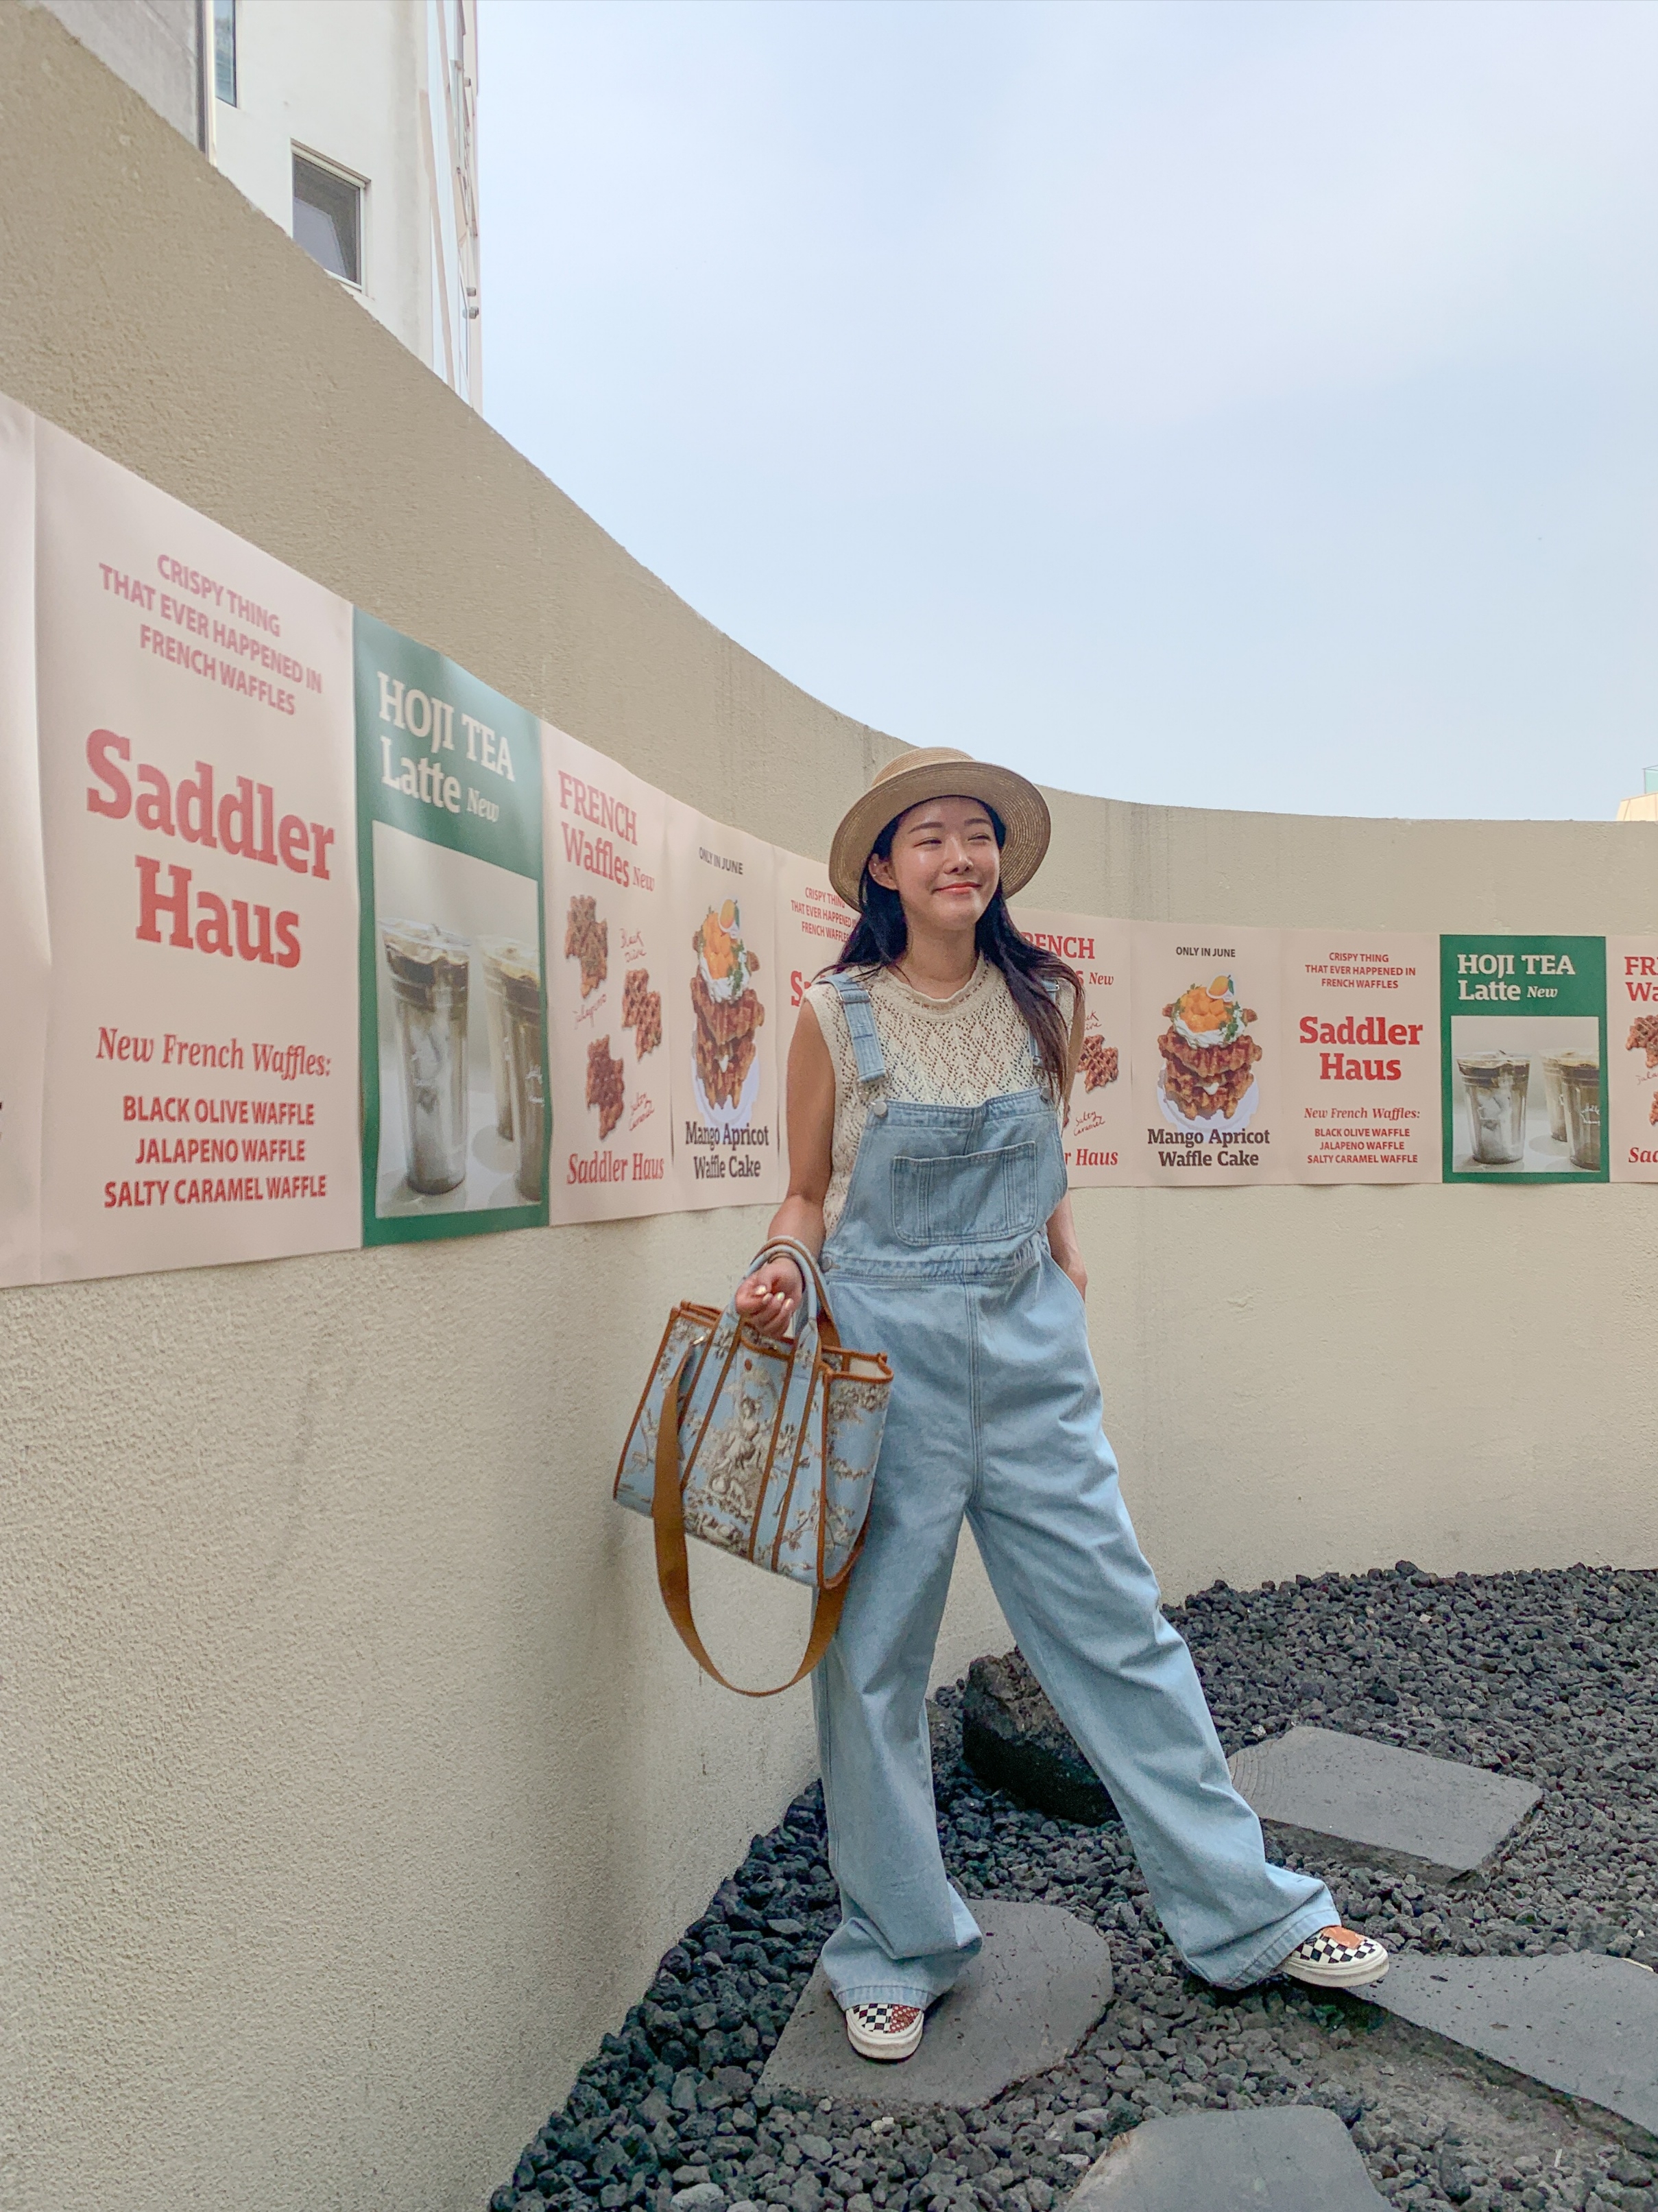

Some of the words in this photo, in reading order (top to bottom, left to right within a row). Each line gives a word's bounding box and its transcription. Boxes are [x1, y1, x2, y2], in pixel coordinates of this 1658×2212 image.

[157, 554, 224, 606] CRISPY
[227, 588, 280, 637] THING
[99, 562, 156, 611] THAT
[160, 593, 209, 638] EVER
[213, 623, 303, 684] HAPPENED
[306, 667, 322, 693] IN
[140, 623, 216, 681] FRENCH
[219, 661, 295, 715] WAFFLES
[377, 671, 455, 753] HOJI
[461, 713, 515, 782] TEA
[381, 735, 461, 813] Latte
[467, 787, 500, 822] New
[86, 728, 335, 880] Saddler
[558, 770, 638, 846] FRENCH
[561, 821, 629, 888] Waffles
[632, 866, 655, 892] New
[699, 846, 713, 865] ONLY
[714, 854, 721, 869] IN
[721, 857, 743, 875] JUNE
[805, 887, 826, 903] CRISPY
[134, 855, 301, 968] Haus
[791, 900, 805, 915] THAT
[806, 907, 822, 920] EVER
[822, 909, 852, 928] HAPPENED
[802, 921, 825, 938] FRENCH
[1176, 947, 1199, 956] ONLY
[1201, 948, 1211, 957] IN
[1212, 948, 1236, 958] JUNE
[1329, 952, 1358, 962] CRISPY
[1360, 953, 1389, 963] THING
[1456, 953, 1515, 978] HOJI
[1521, 955, 1576, 975] TEA
[1089, 972, 1114, 986] New
[1305, 964, 1328, 974] THAT
[1330, 965, 1351, 975] EVER
[1352, 966, 1404, 976] HAPPENED
[1406, 967, 1416, 976] IN
[1321, 978, 1354, 988] FRENCH
[1356, 979, 1399, 989] WAFFLES
[1458, 979, 1521, 1001] Latte
[1526, 986, 1558, 998] New
[1299, 1016, 1423, 1045] Saddler
[96, 1027, 154, 1062] New
[162, 1034, 244, 1070] French
[252, 1043, 331, 1080] Waffles:
[1319, 1052, 1402, 1081] Haus
[123, 1095, 189, 1122] BLACK
[194, 1099, 249, 1124] OLIVE
[251, 1101, 315, 1125] WAFFLE
[1303, 1108, 1328, 1119] New
[1331, 1108, 1368, 1119] French
[1372, 1107, 1421, 1121] Waffles:
[685, 1121, 721, 1151] Mango
[722, 1122, 769, 1151] Apricot
[1147, 1128, 1203, 1147] Mango
[1208, 1128, 1270, 1147] Apricot
[1314, 1128, 1343, 1137] BLACK
[1343, 1128, 1370, 1137] OLIVE
[1371, 1128, 1410, 1137] WAFFLE
[1319, 1141, 1365, 1150] JALAPENO
[1366, 1141, 1405, 1150] WAFFLE
[135, 1139, 239, 1163] JALAPENO
[242, 1139, 305, 1162] WAFFLE
[1076, 1148, 1118, 1166] Haus
[1158, 1150, 1212, 1167] Waffle
[1217, 1150, 1259, 1166] Cake
[1307, 1154, 1334, 1164] SALTY
[1335, 1154, 1379, 1164] CARAMEL
[1380, 1154, 1418, 1163] WAFFLE
[566, 1150, 628, 1185] Saddler
[632, 1152, 665, 1180] Haus
[693, 1154, 726, 1179] Waffle
[728, 1154, 761, 1178] Cake
[104, 1179, 168, 1207] SALTY
[174, 1177, 263, 1204] CARAMEL
[266, 1175, 327, 1198] WAFFLE
